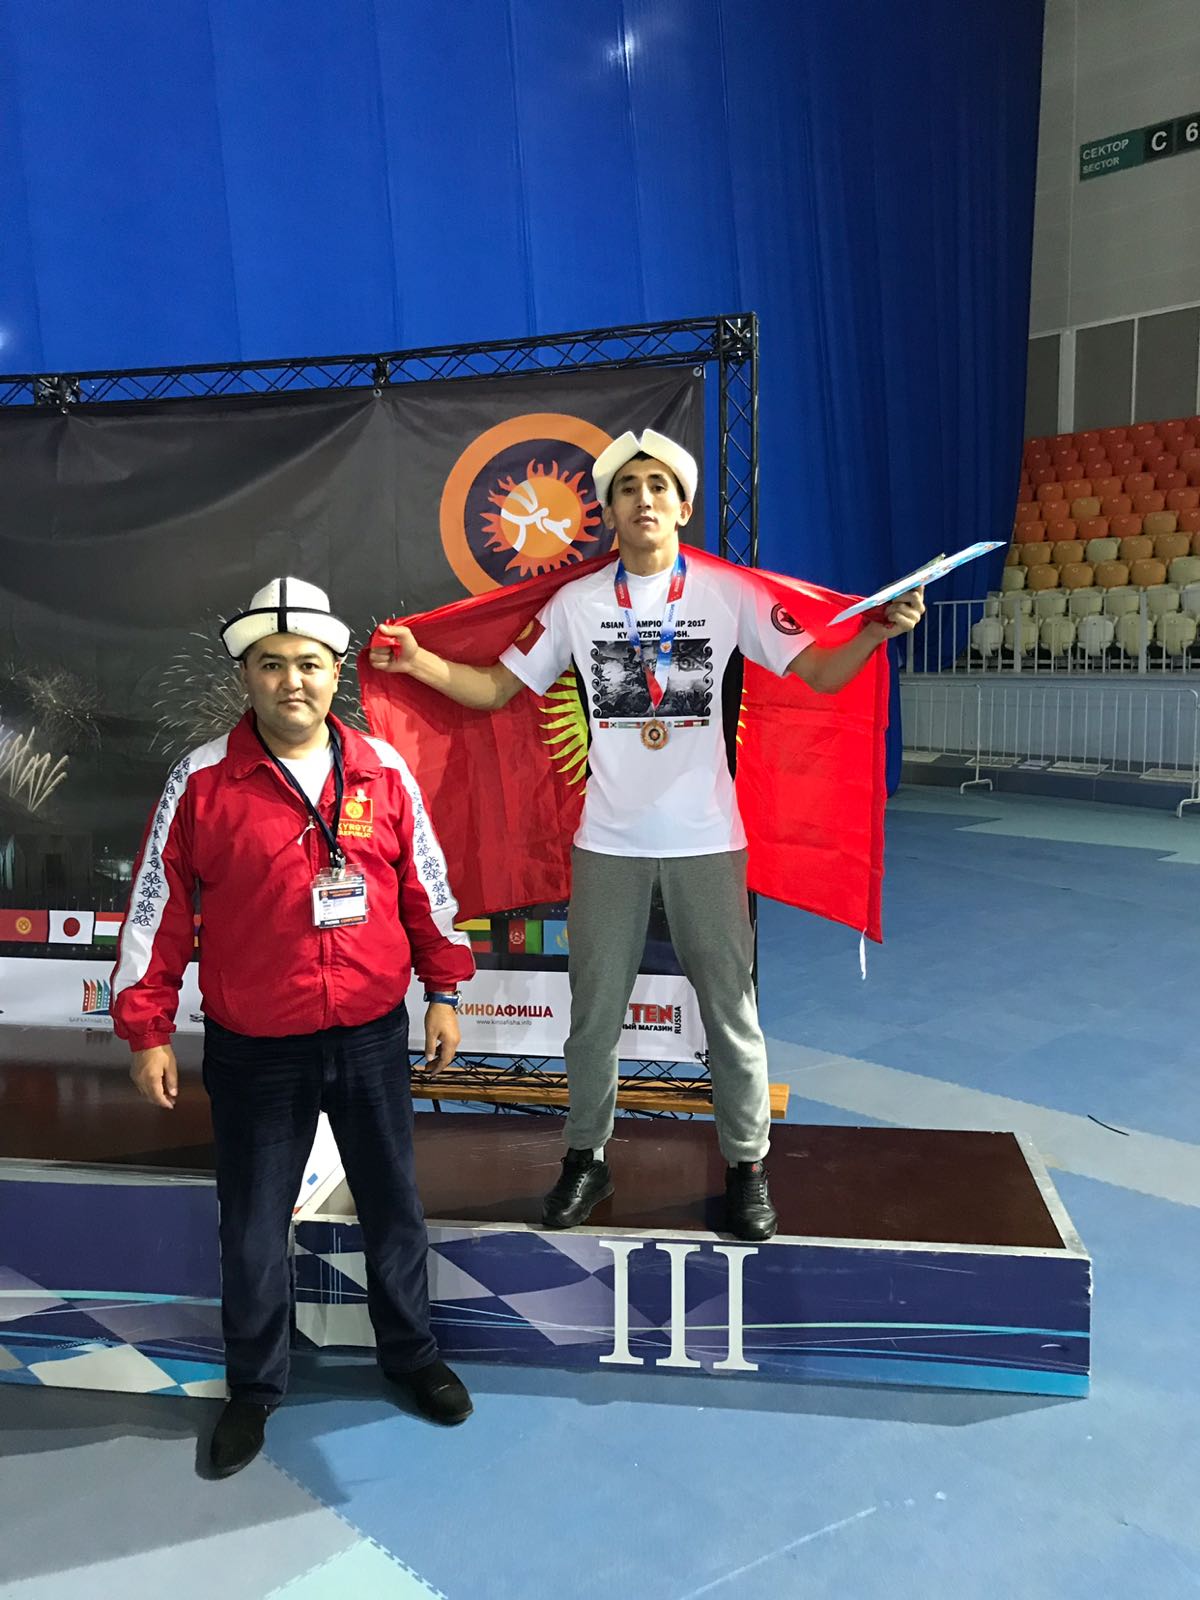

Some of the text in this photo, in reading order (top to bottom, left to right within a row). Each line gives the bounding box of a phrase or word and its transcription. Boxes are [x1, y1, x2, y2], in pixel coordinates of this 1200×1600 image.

[1185, 122, 1199, 142] 6
[1082, 139, 1129, 160] СЕКТОР
[1082, 157, 1120, 173] SECTOR
[600, 619, 706, 629] ASIAN AMPIOIP 2017
[617, 630, 661, 639] KYYZSTA
[456, 1003, 553, 1018] КИНОАФИША
[638, 1024, 673, 1032] МАГАЗИН
[674, 1006, 682, 1034] RUSSIA
[599, 1240, 759, 1371] III
